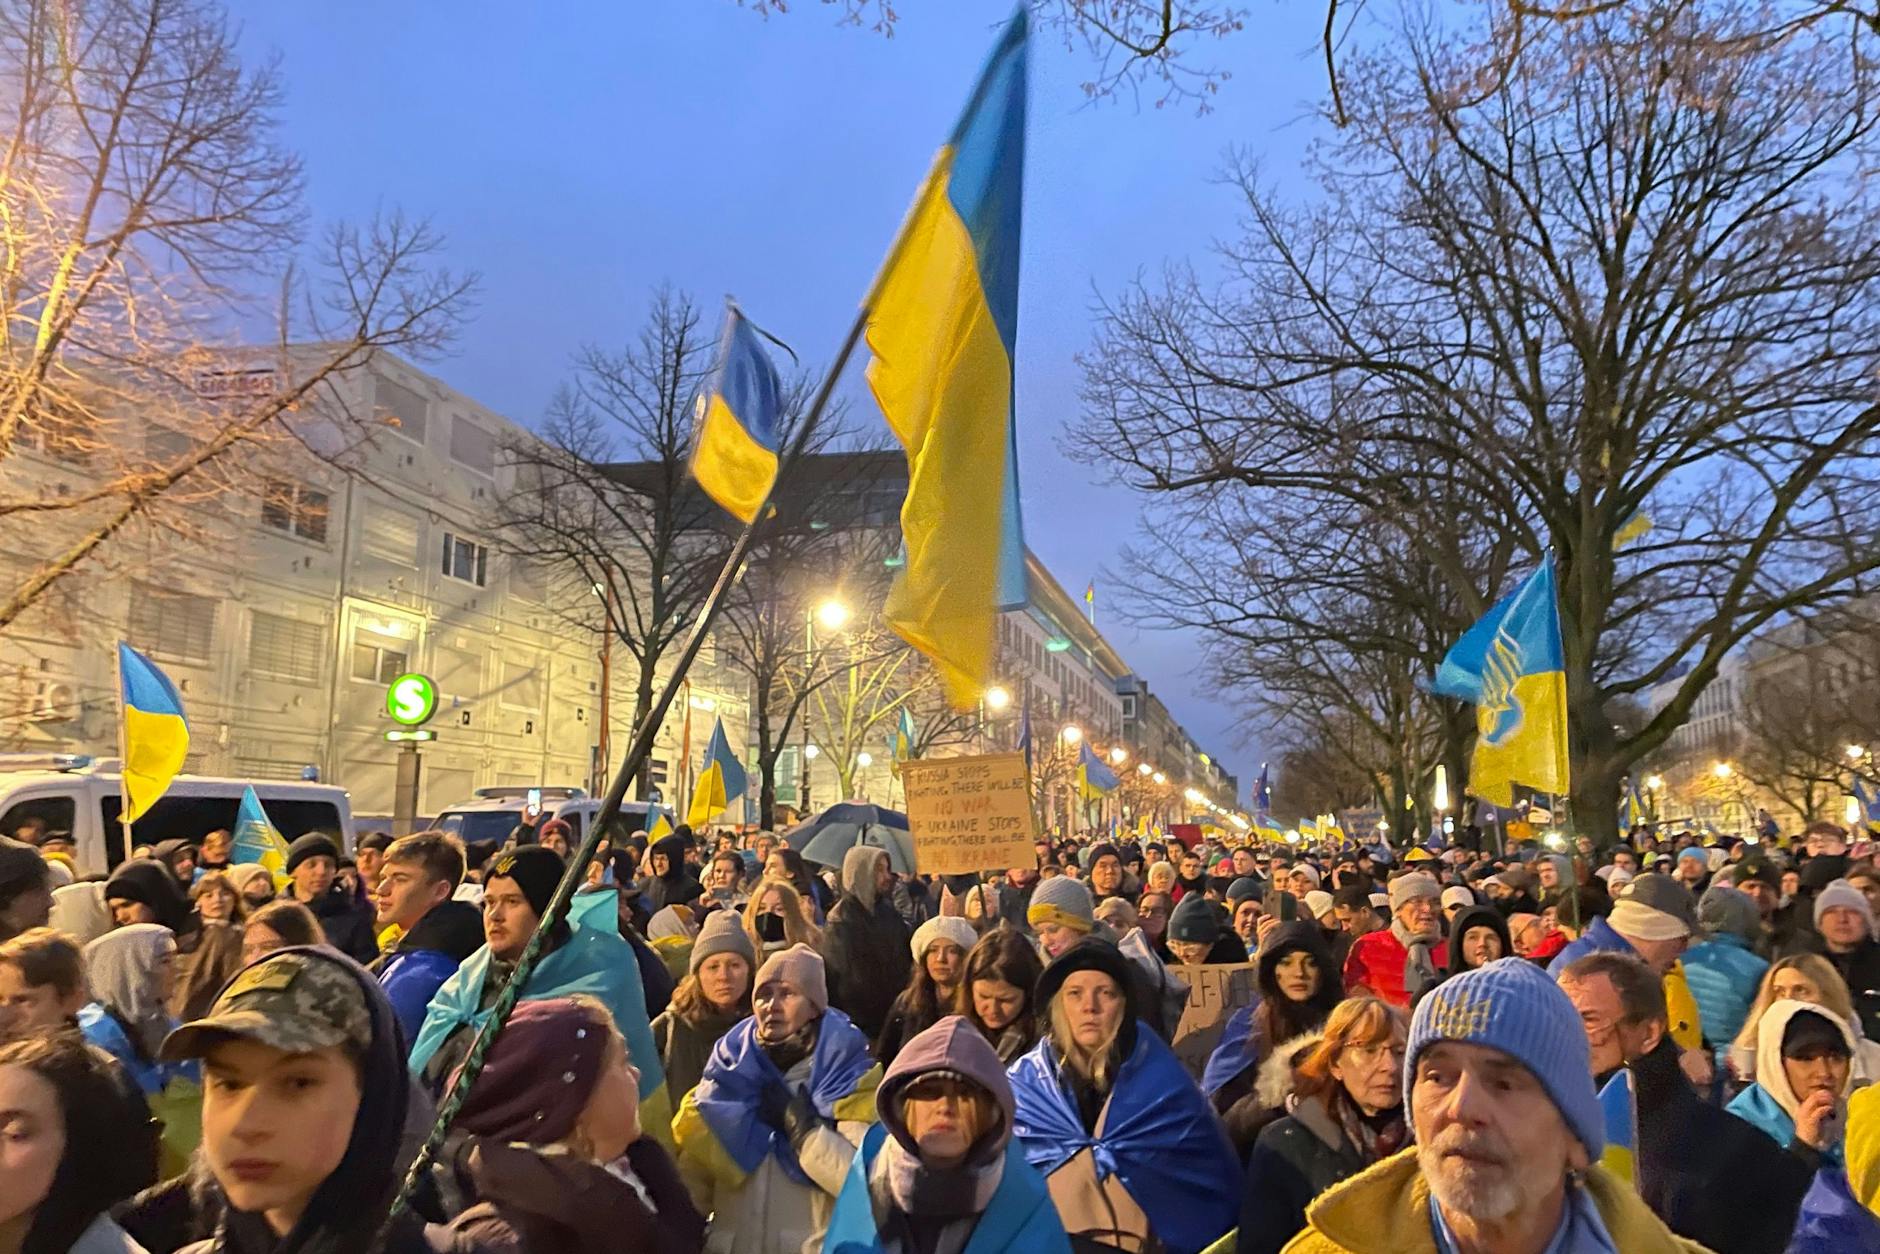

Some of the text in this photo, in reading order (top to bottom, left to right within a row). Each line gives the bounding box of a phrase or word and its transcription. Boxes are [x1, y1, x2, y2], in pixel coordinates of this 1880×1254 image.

[394, 679, 425, 720] S
[917, 768, 950, 784] RUSSIA
[957, 764, 991, 778] STOPS
[951, 780, 984, 794] THERE
[988, 779, 1010, 791] WILL
[1011, 777, 1025, 789] BE
[934, 795, 998, 816] NO WAR
[928, 818, 979, 833] UKRAINE
[988, 816, 1021, 831] STOPS
[1011, 832, 1025, 842] BE
